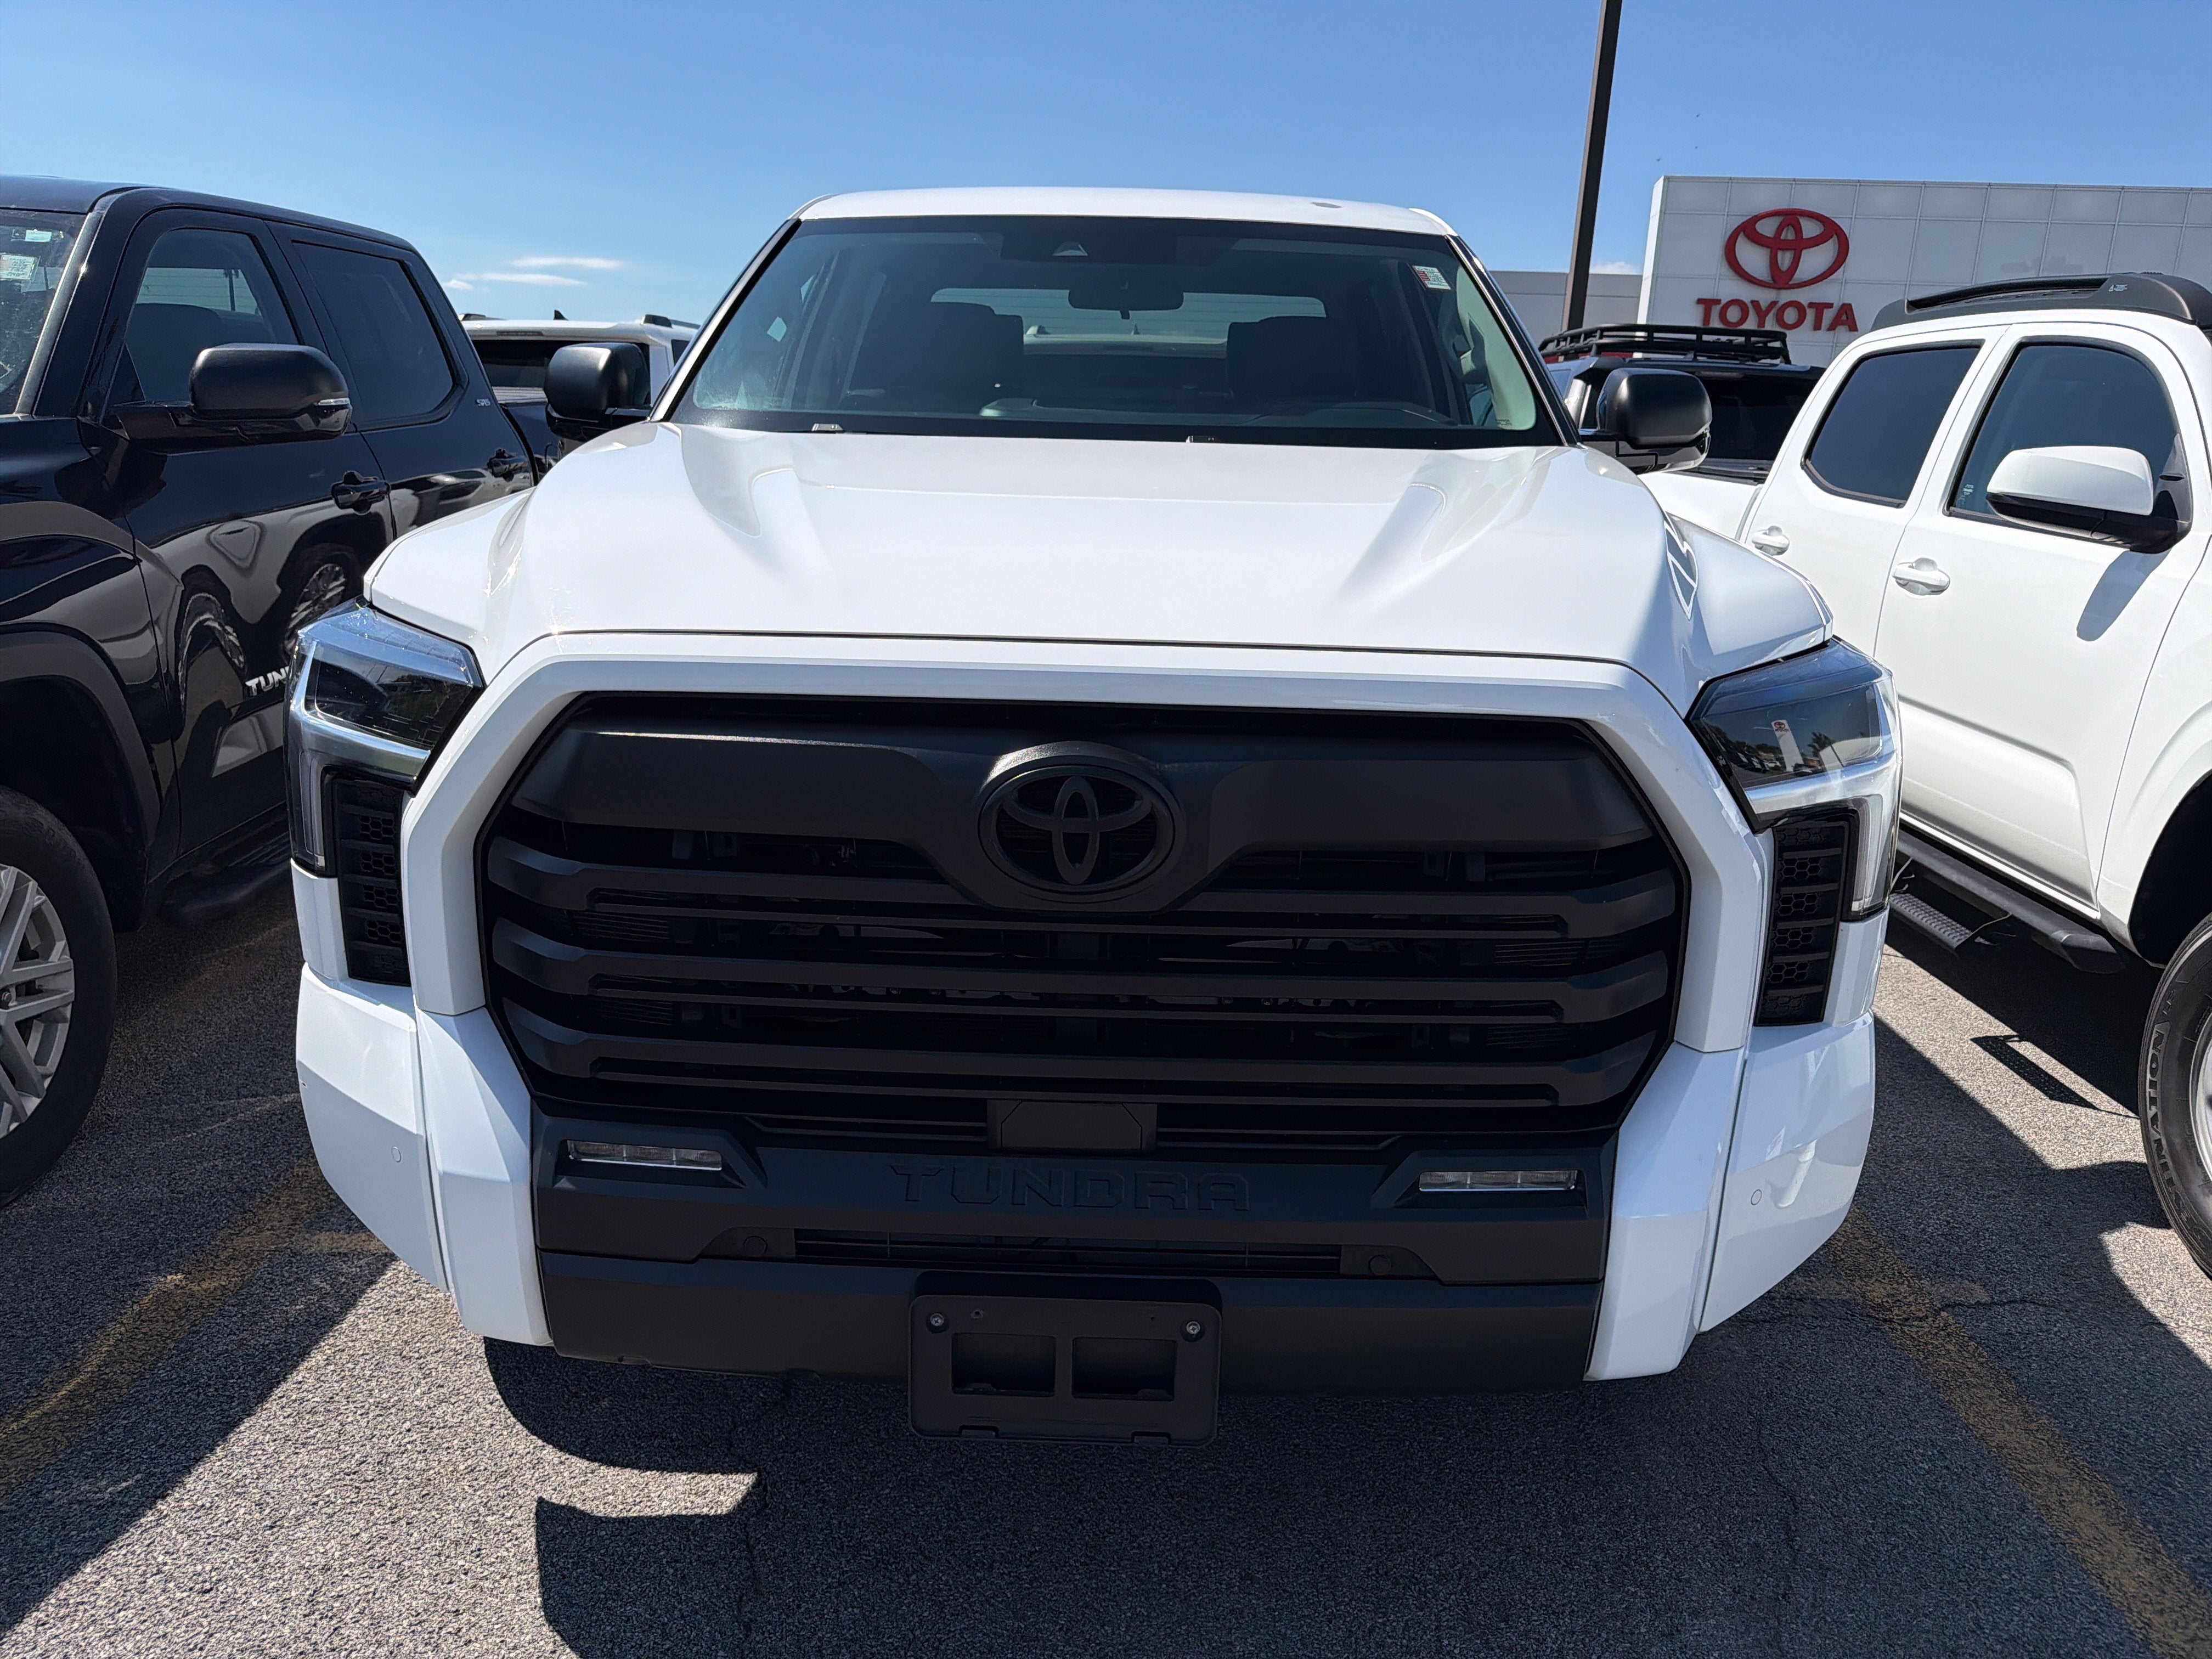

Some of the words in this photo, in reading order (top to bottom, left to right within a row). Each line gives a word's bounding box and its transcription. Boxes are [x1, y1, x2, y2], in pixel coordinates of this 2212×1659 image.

[1696, 298, 1859, 332] TOYOTA
[245, 665, 290, 697] TUN
[890, 1163, 1249, 1211] TUNDRA
